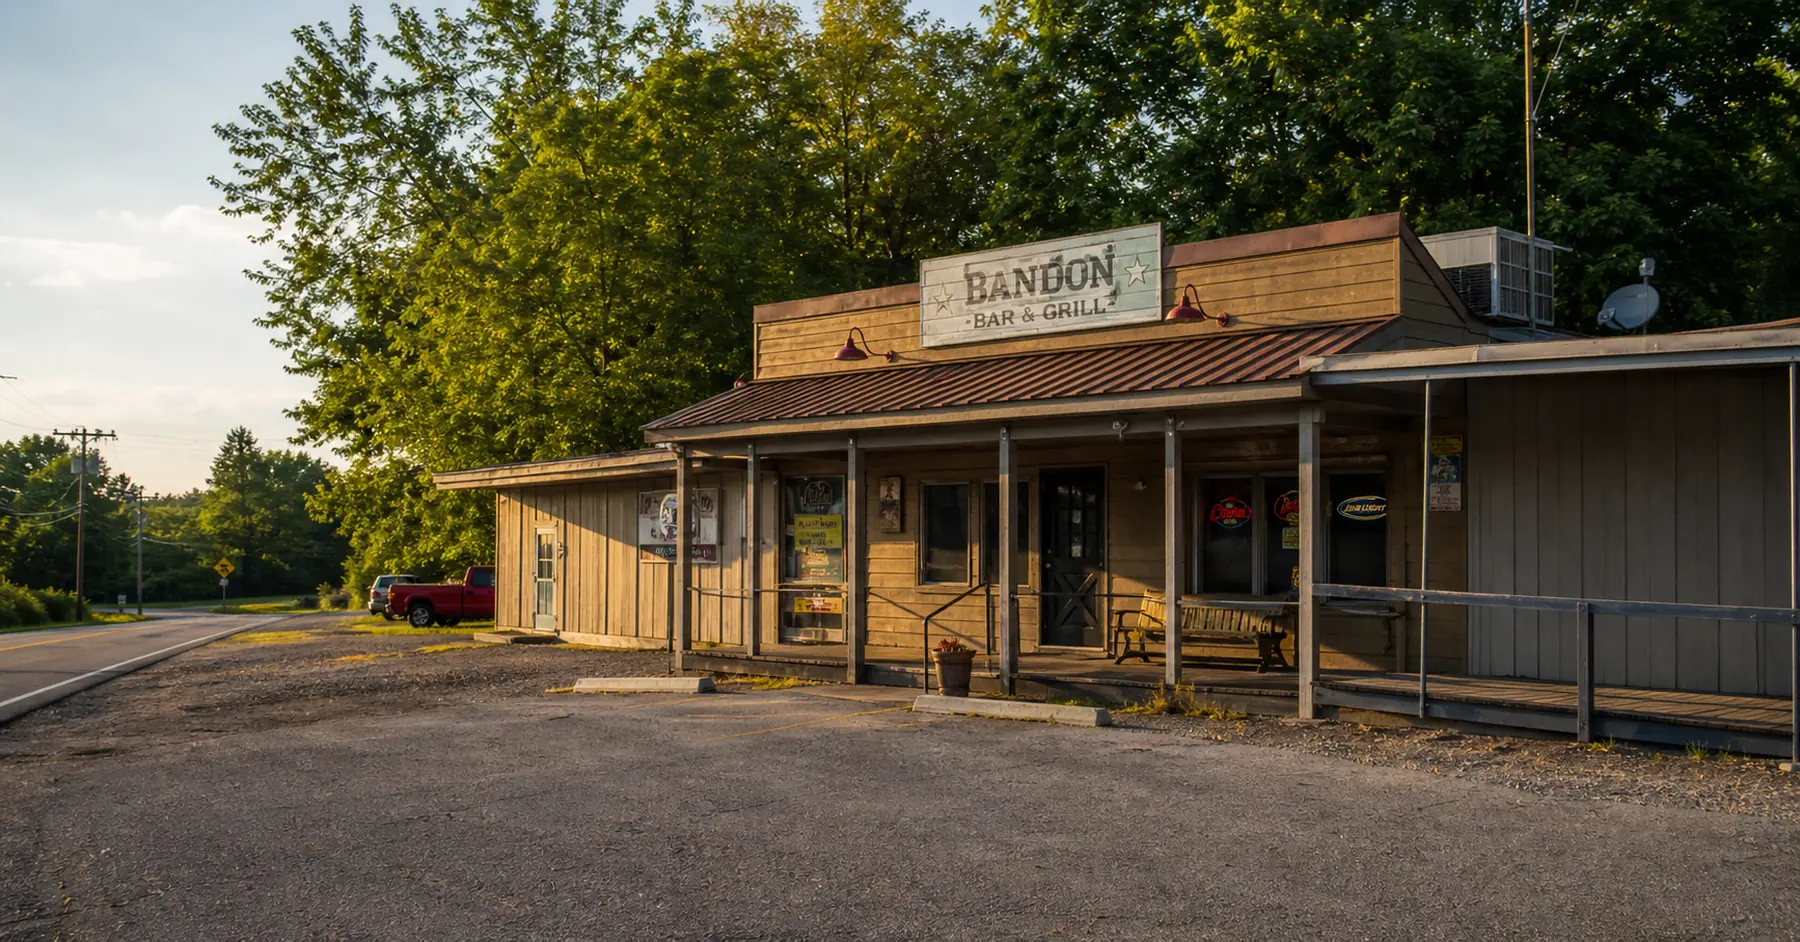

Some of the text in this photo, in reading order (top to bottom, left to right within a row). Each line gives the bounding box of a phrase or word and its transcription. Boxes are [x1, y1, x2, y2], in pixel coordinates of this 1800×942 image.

[964, 253, 1116, 306] BANDON
[973, 298, 1106, 329] BAR & GRILL
